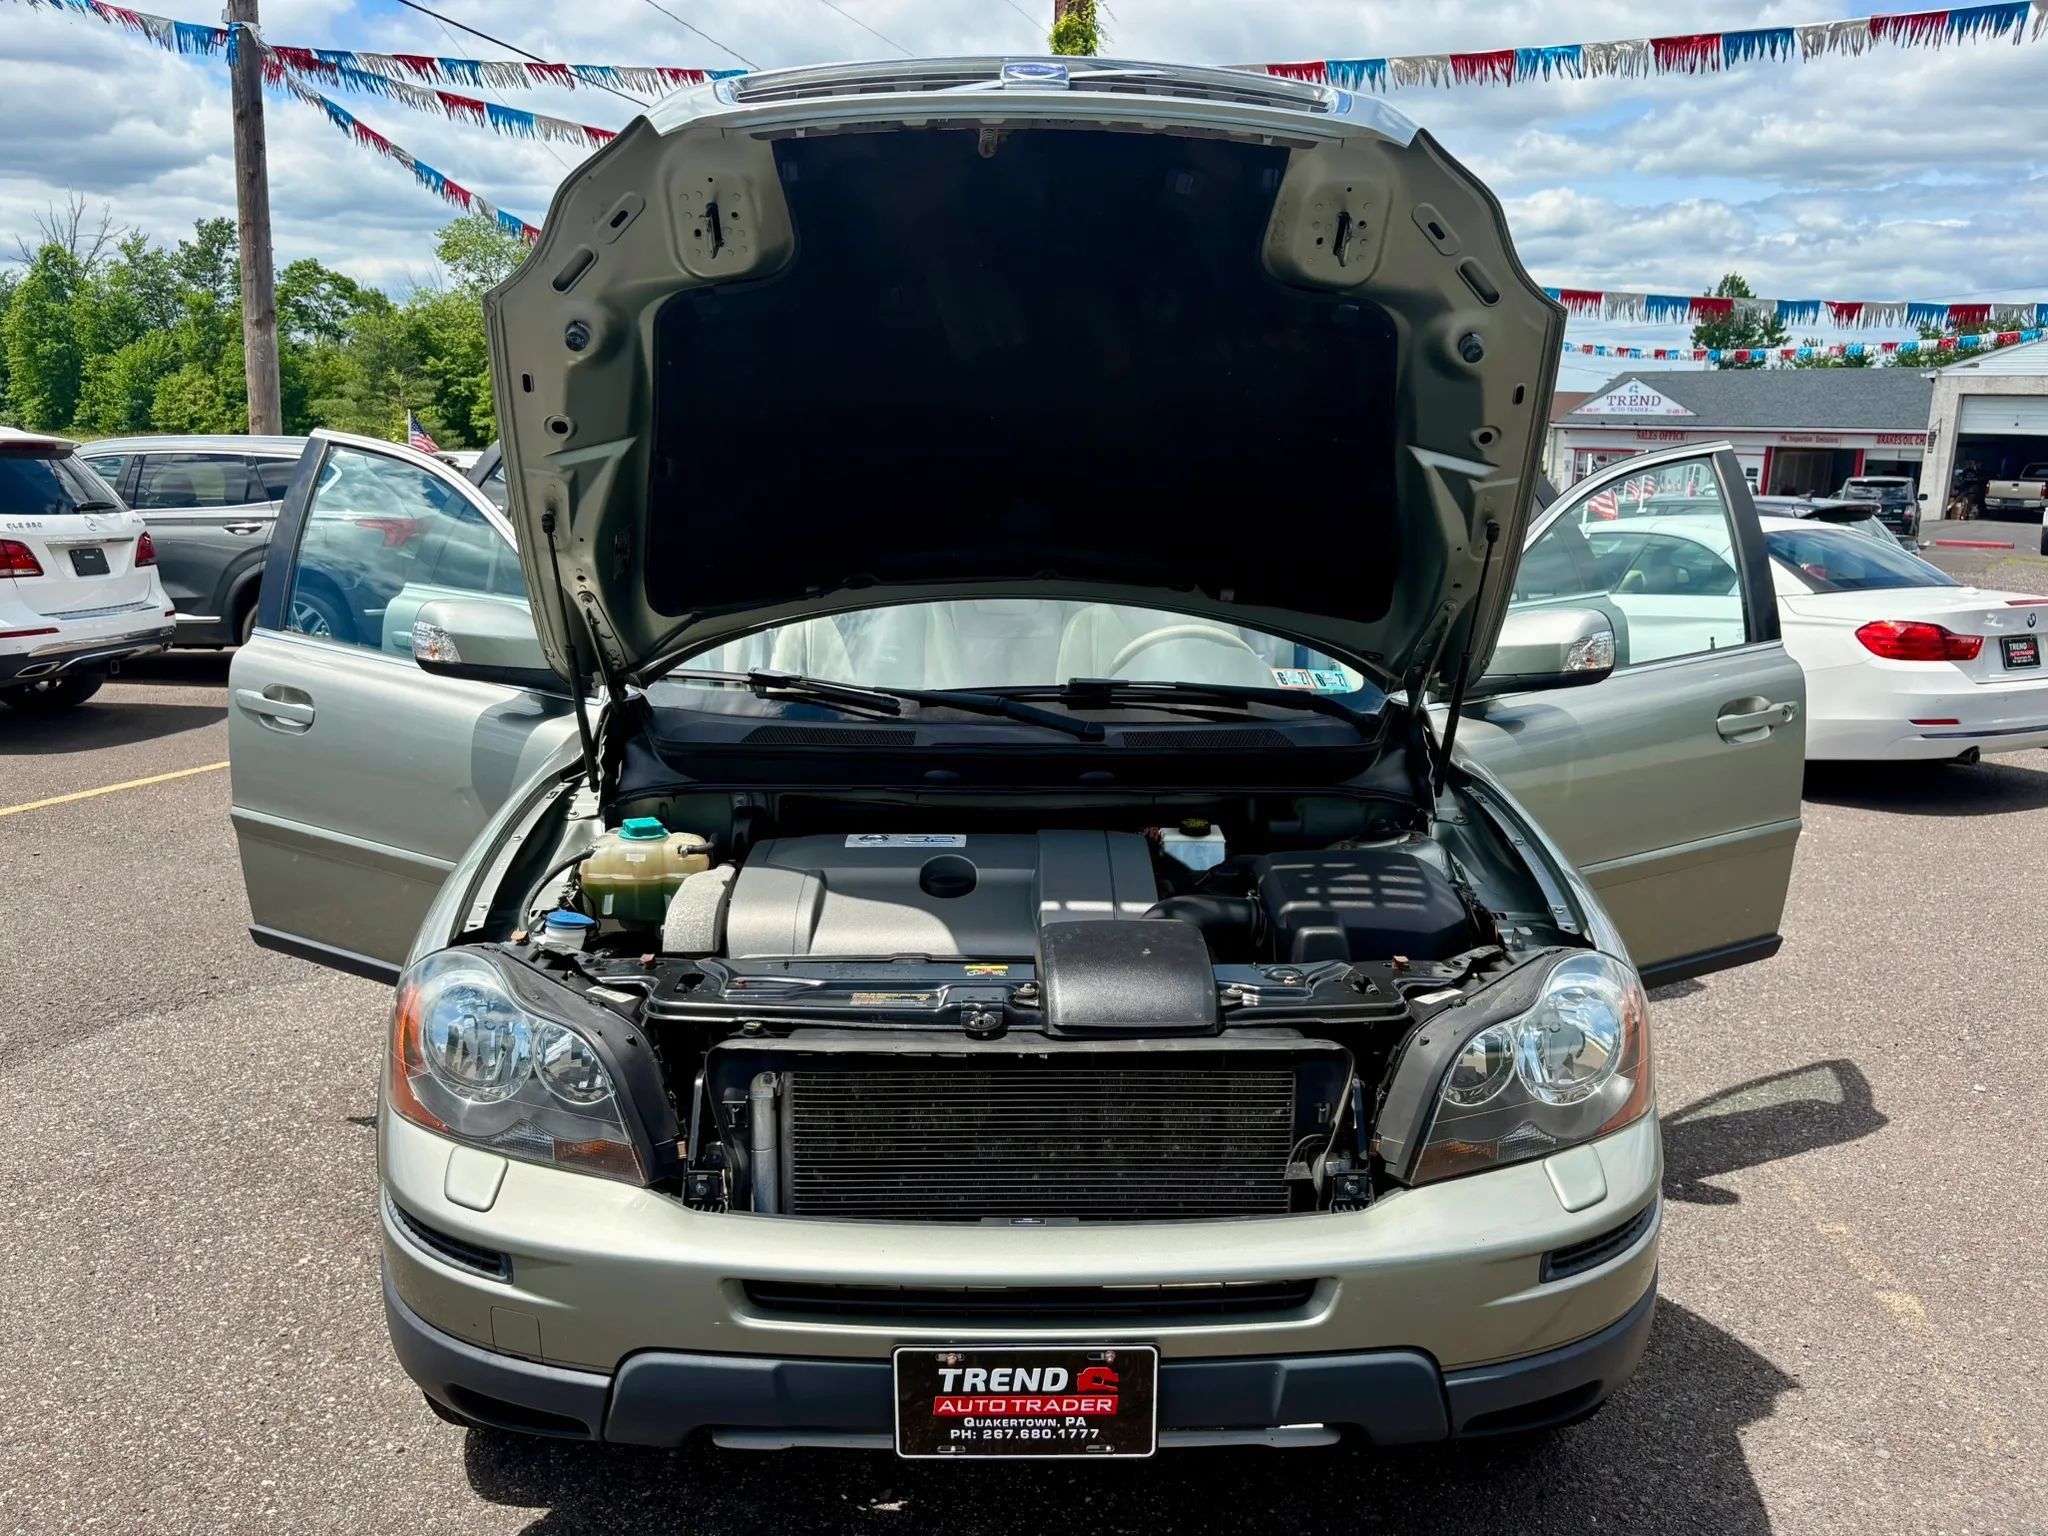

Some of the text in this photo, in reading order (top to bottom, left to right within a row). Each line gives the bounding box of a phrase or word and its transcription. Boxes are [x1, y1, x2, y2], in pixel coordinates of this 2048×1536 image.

[1606, 395, 1661, 407] TREND
[1636, 430, 1685, 441] SALES OFFICE
[1877, 433, 1900, 445] BRAKES
[1903, 433, 1914, 445] OIL
[938, 1367, 1069, 1393] TREND
[938, 1399, 1112, 1412] AUTO TRADER
[1065, 1417, 1086, 1427] PA
[950, 1429, 1099, 1439] PH: 267.680.1777
